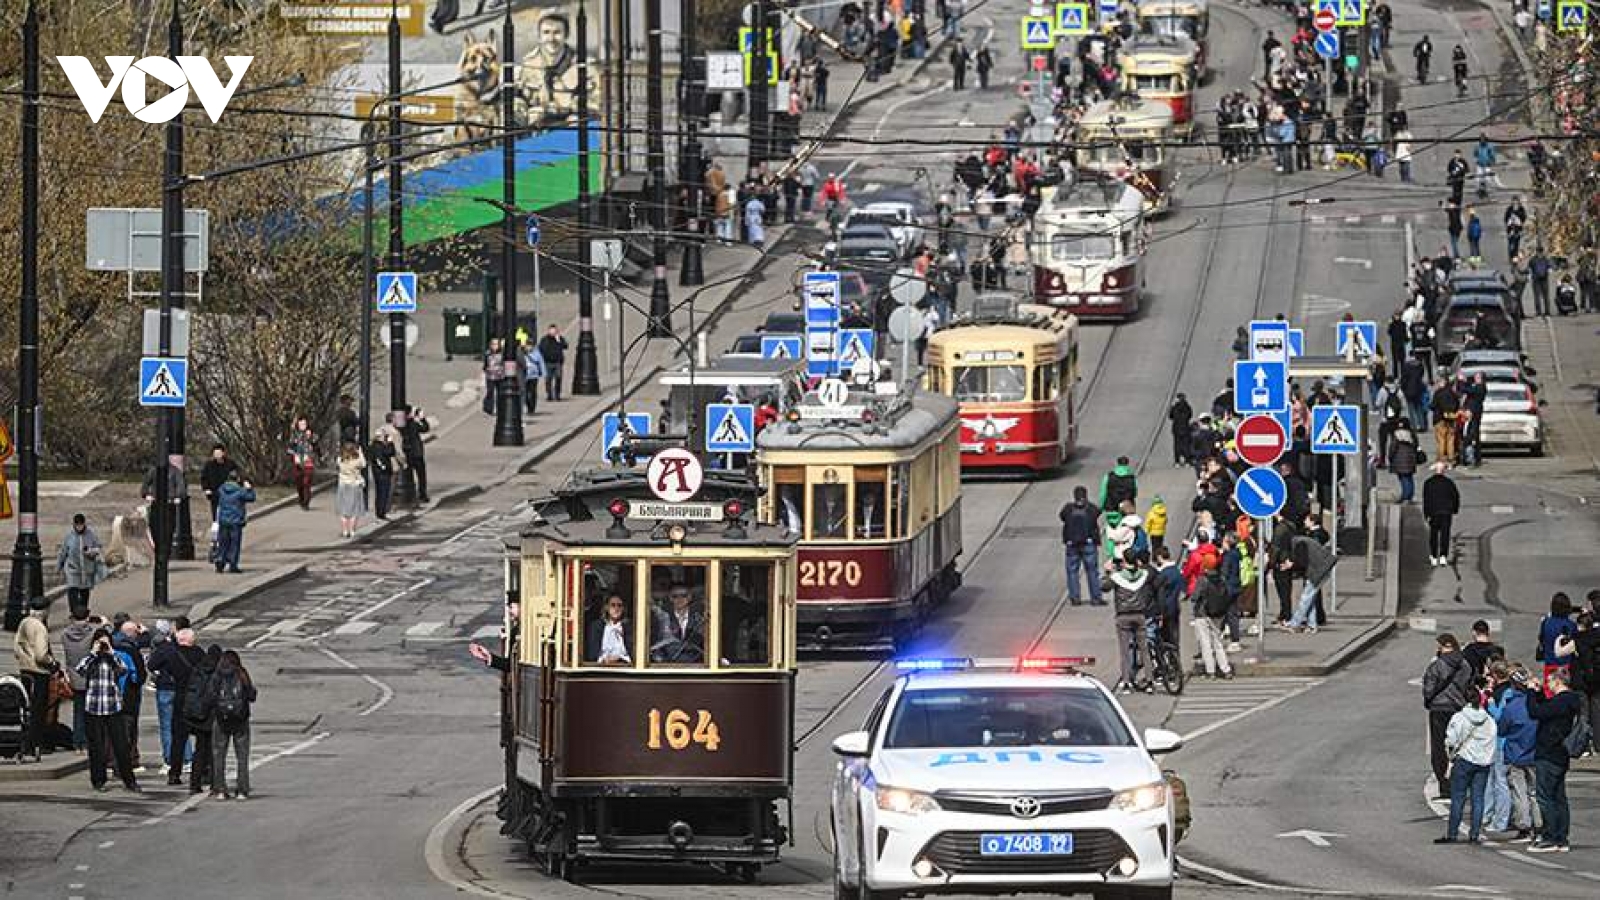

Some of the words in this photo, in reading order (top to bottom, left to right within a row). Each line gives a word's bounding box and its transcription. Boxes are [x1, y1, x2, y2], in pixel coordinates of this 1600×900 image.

[799, 560, 863, 587] 2170
[647, 707, 721, 751] 164
[929, 750, 1105, 767] ДПС
[1004, 836, 1043, 852] 7408
